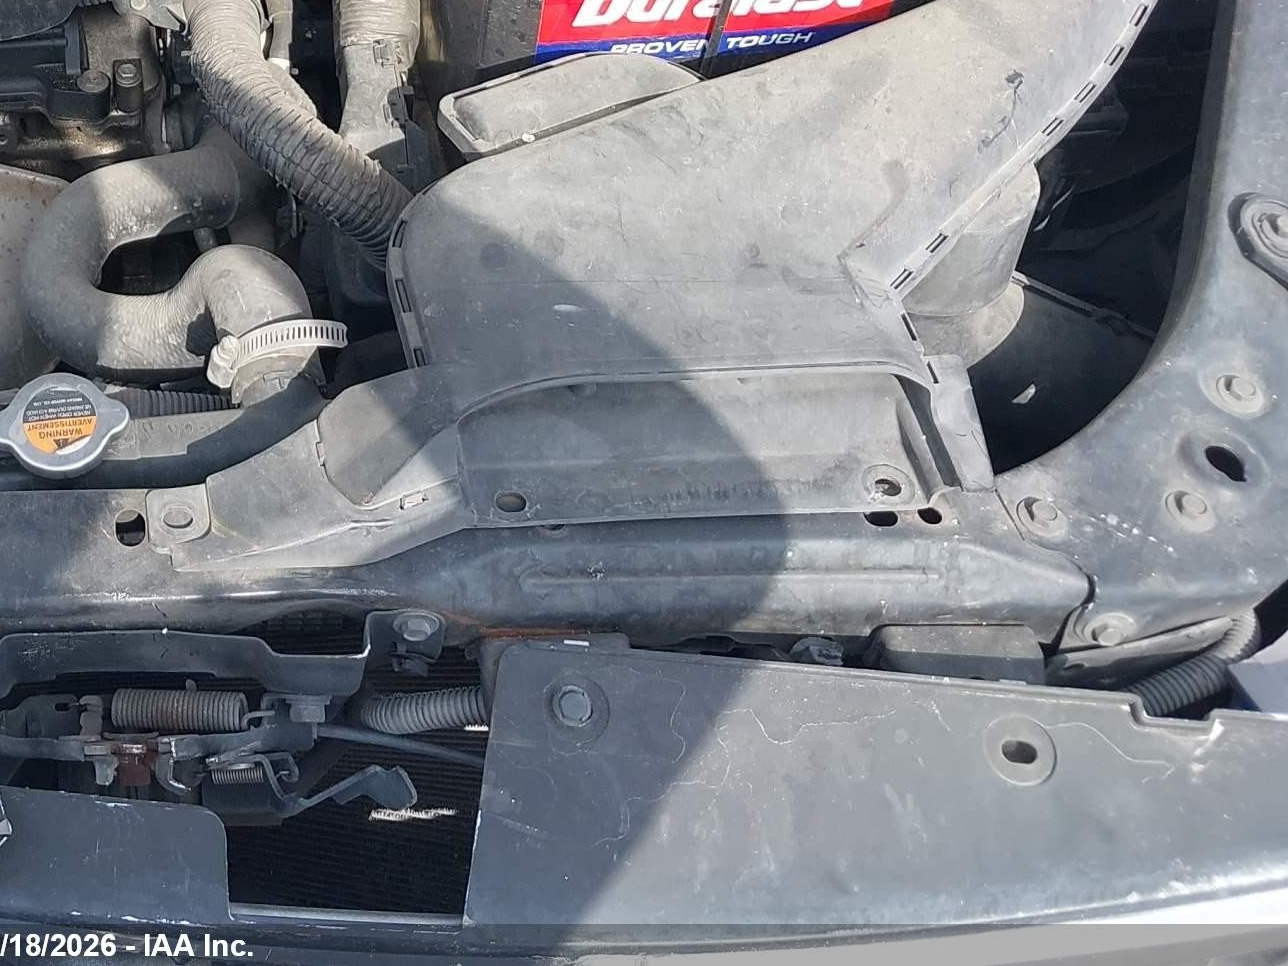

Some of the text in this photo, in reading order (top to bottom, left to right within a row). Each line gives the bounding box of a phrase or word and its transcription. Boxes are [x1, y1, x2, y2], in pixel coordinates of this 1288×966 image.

[727, 32, 816, 48] TOUGH
[27, 418, 93, 432] AVERTISSEMENT
[38, 427, 84, 440] WARNING
